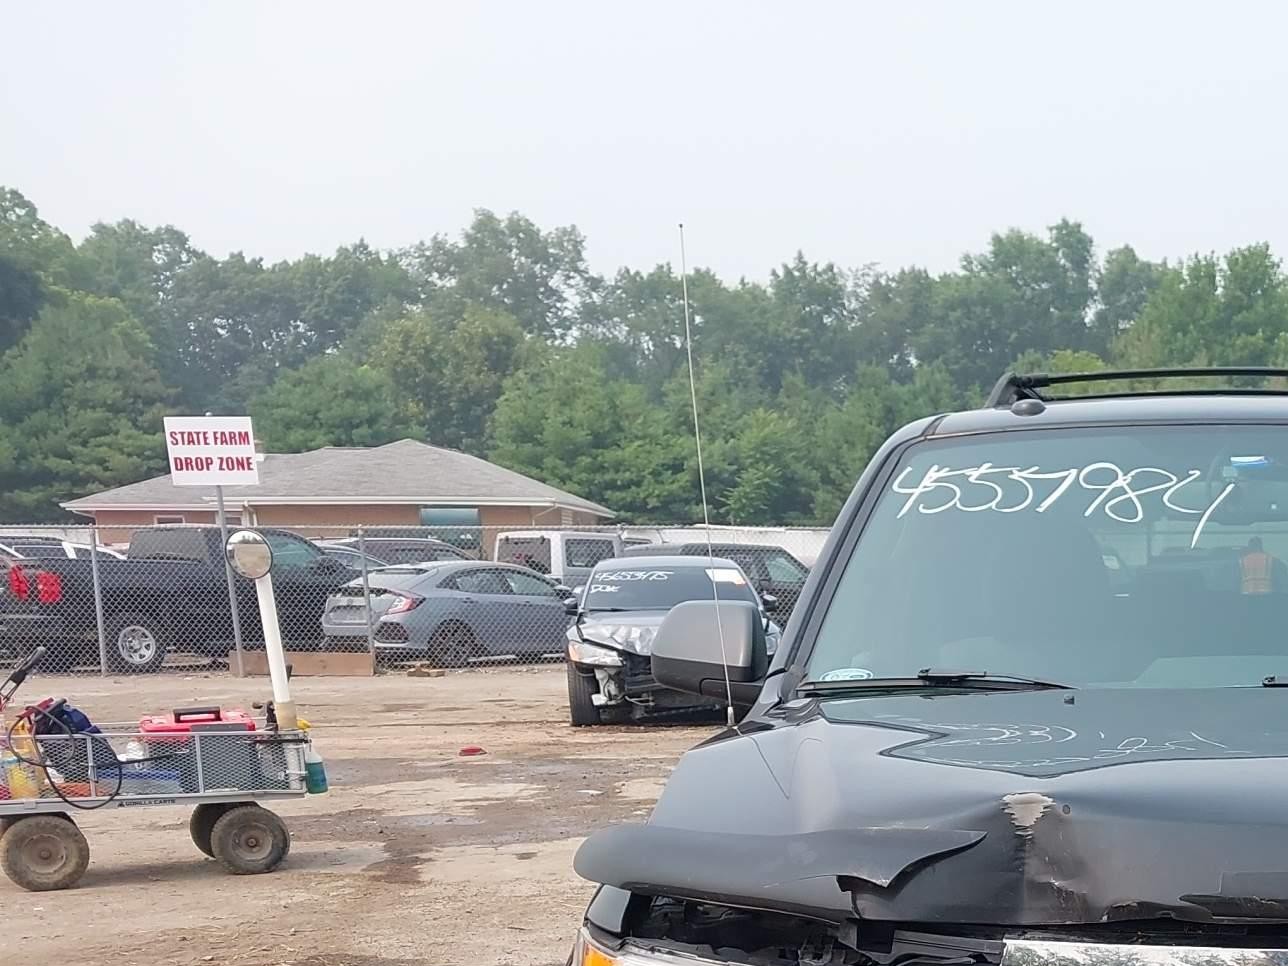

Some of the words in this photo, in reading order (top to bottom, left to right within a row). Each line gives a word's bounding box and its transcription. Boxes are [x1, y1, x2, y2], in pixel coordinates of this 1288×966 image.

[169, 430, 210, 446] STATE
[213, 431, 250, 446] FARM
[174, 456, 215, 472] DROP
[218, 456, 254, 472] ZONE
